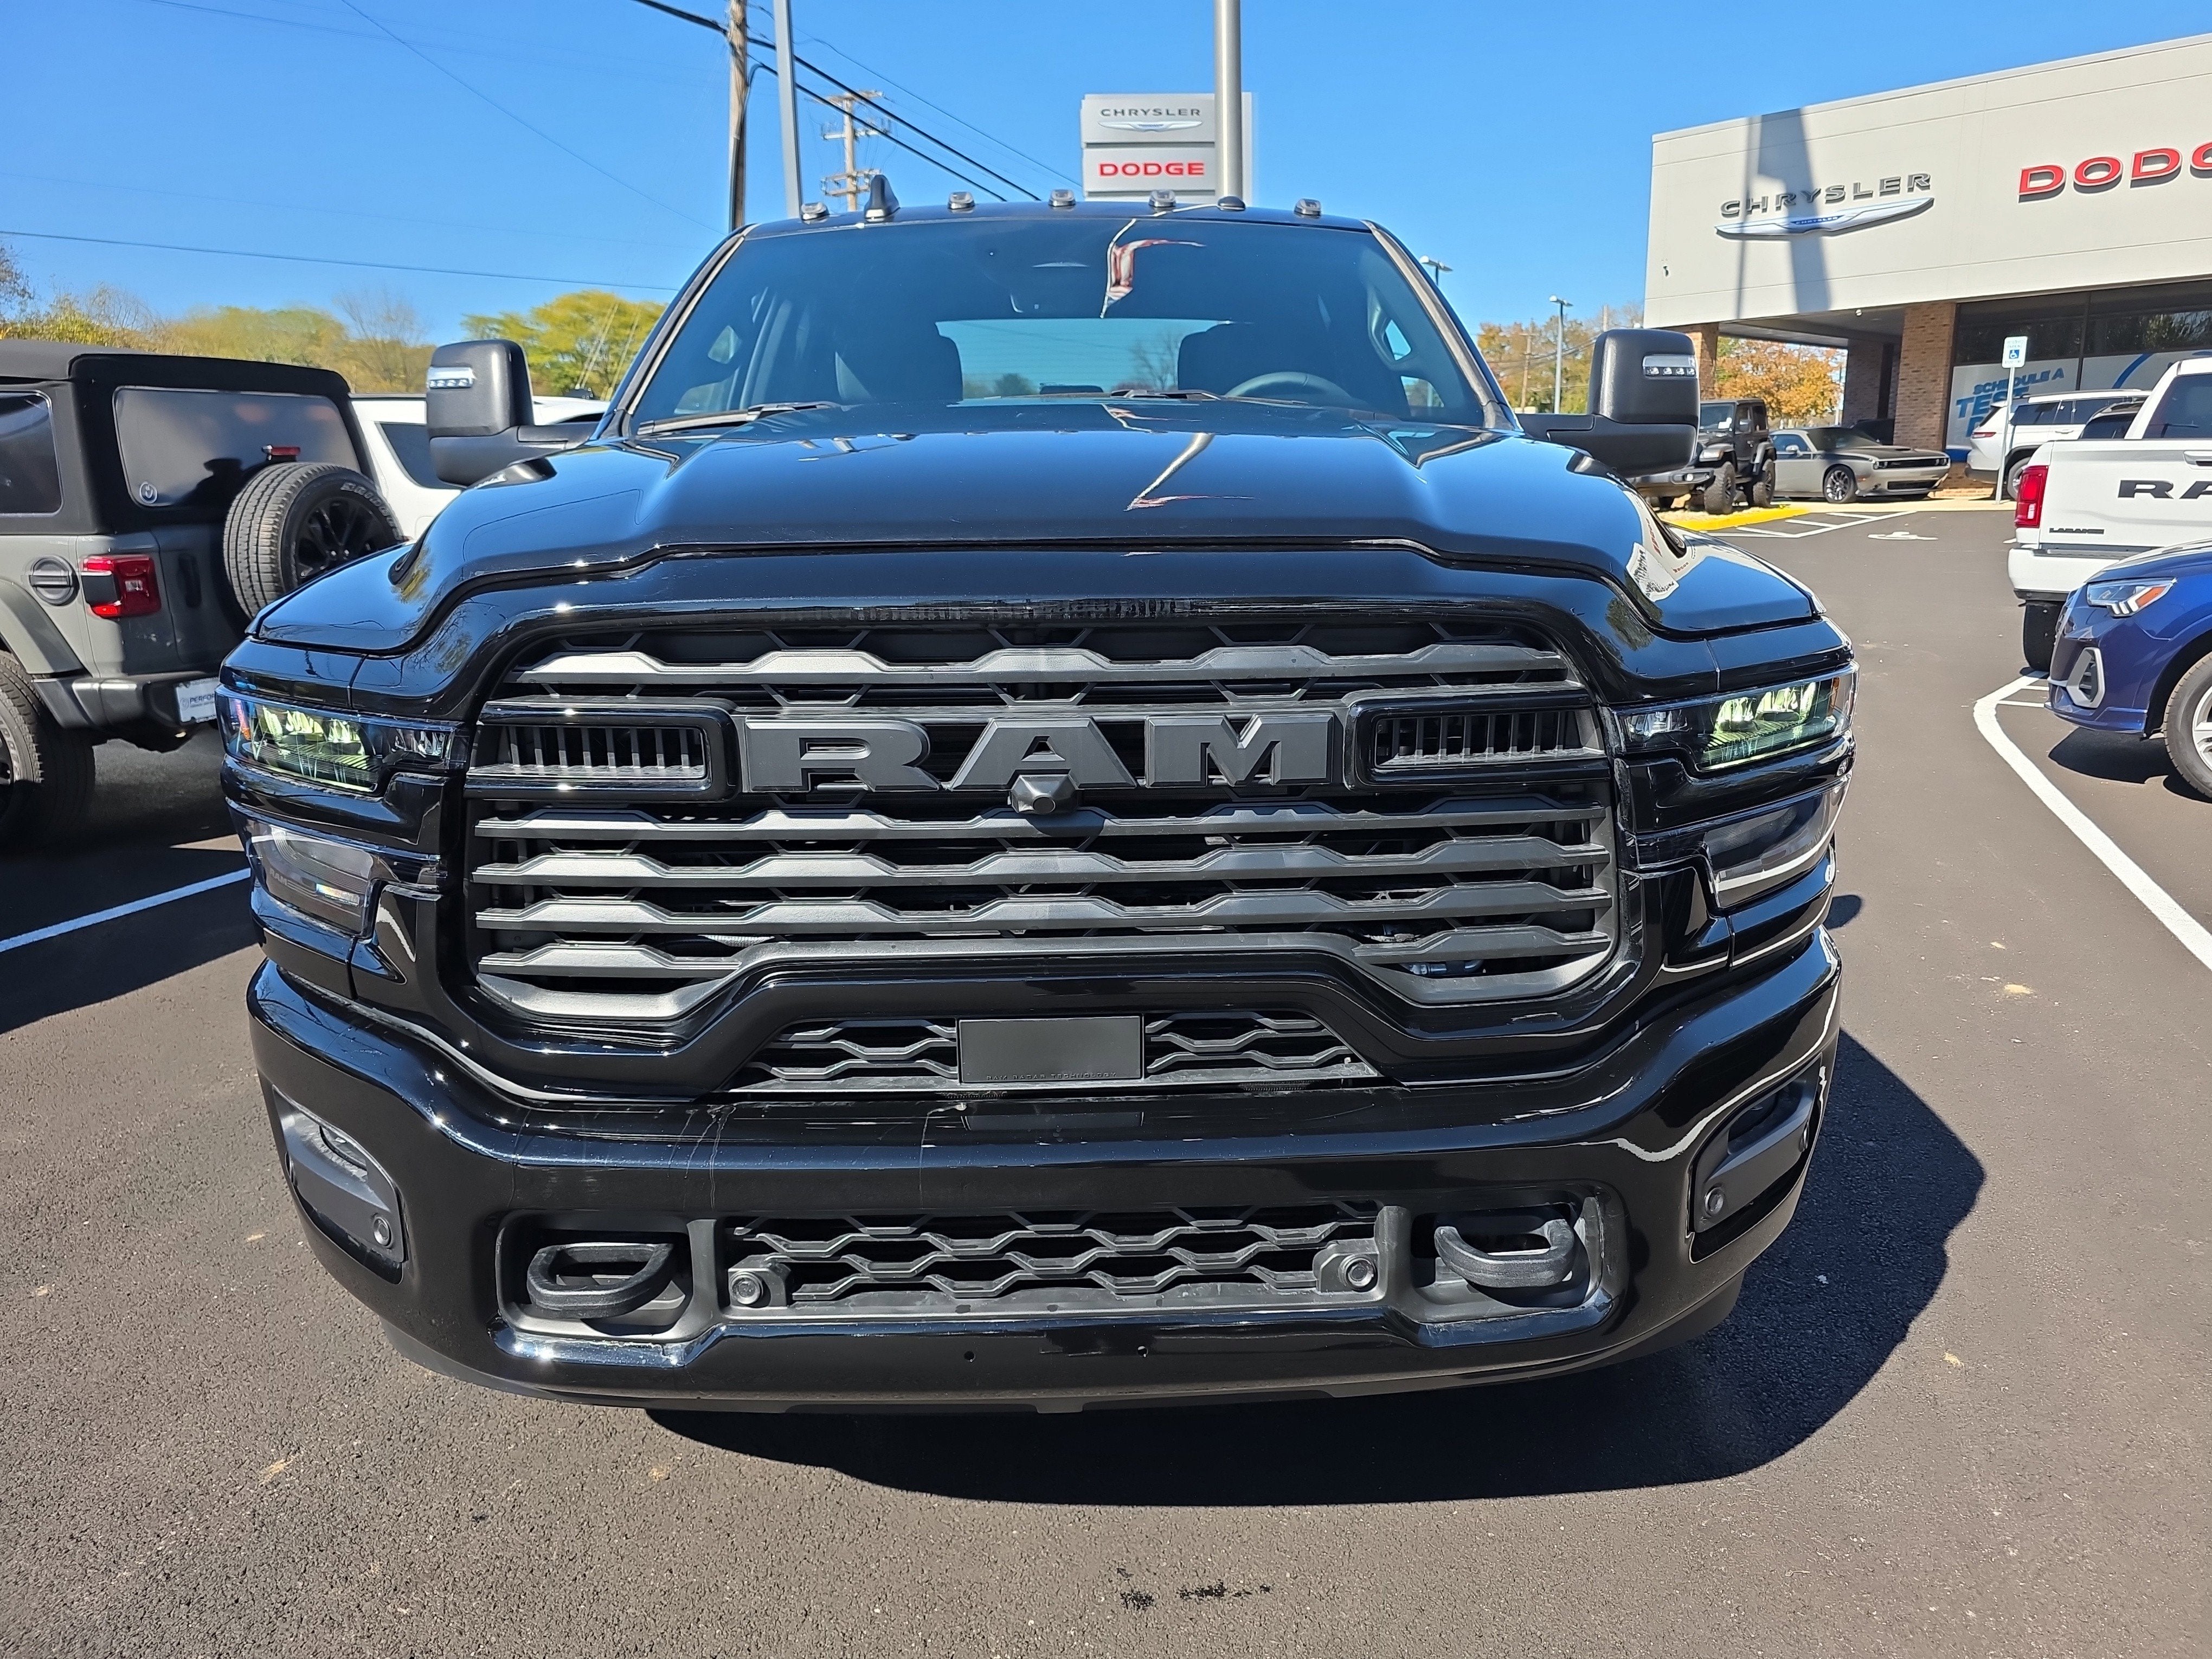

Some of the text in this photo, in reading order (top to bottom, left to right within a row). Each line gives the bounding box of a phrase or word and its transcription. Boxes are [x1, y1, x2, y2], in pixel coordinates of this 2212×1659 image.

[1101, 108, 1200, 117] CHRYSLER
[1099, 163, 1204, 176] DODGE
[1720, 172, 1931, 218] CHRYSLER
[744, 712, 1335, 793] RAM
[1051, 1071, 1117, 1079] TECHNOLOGY
